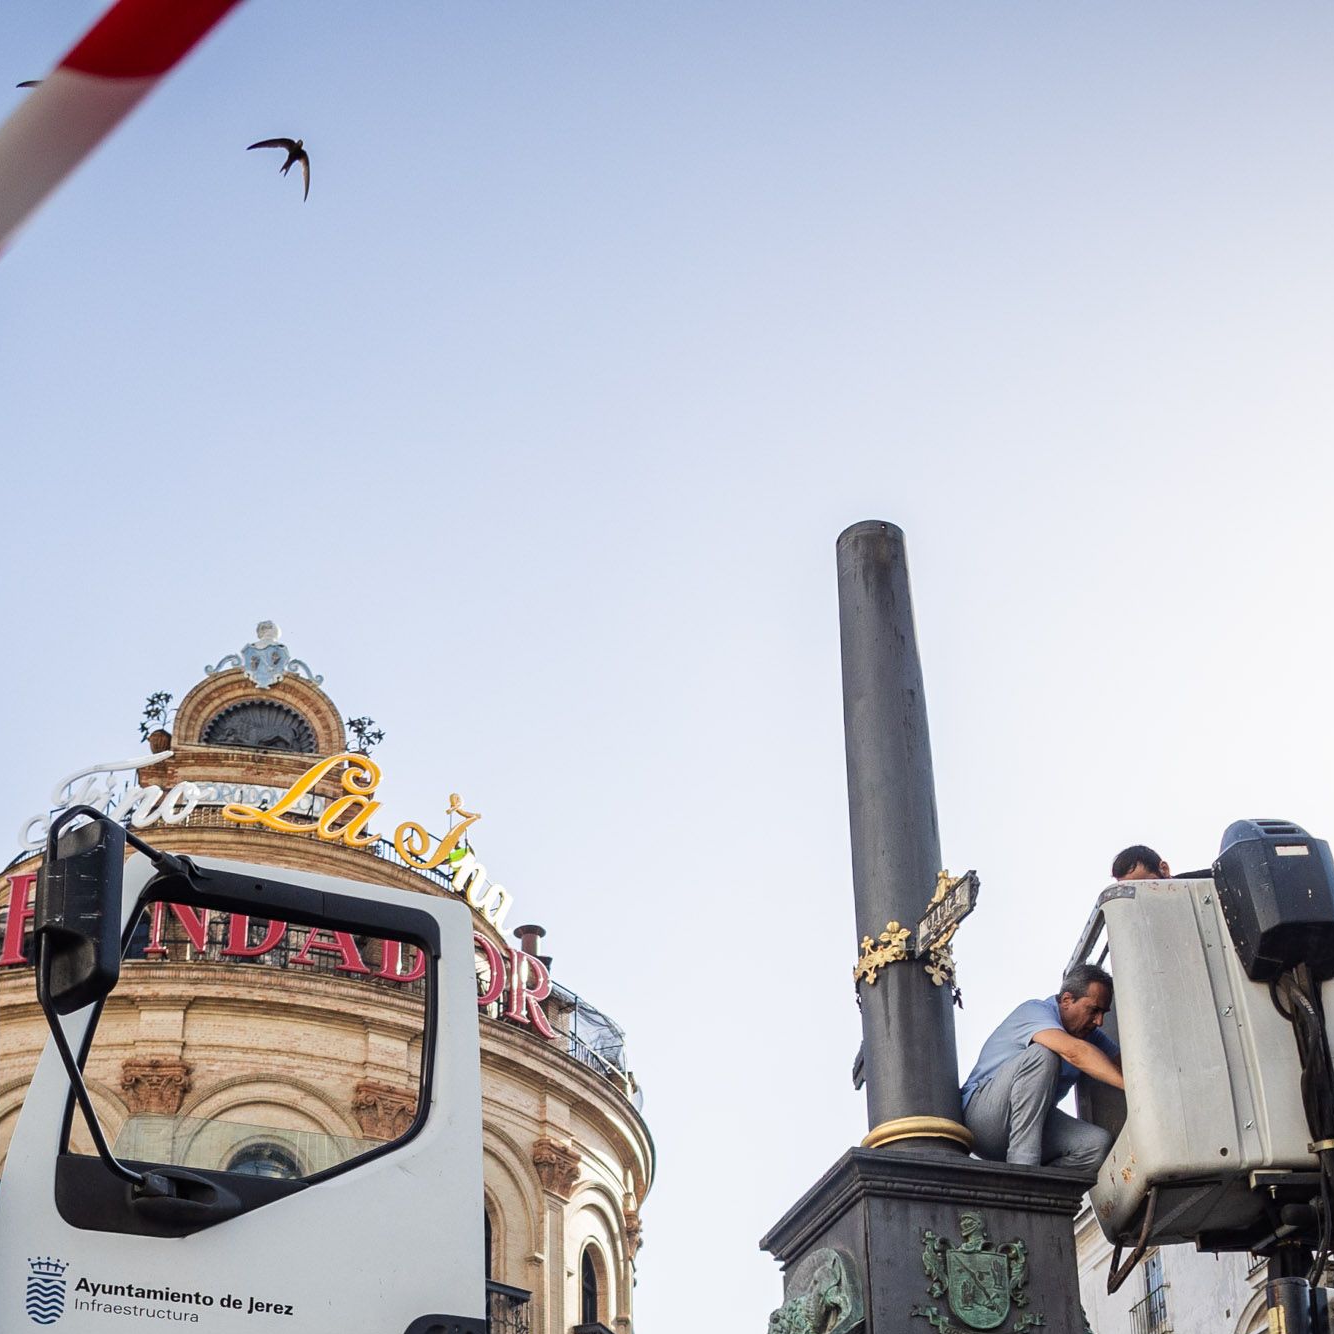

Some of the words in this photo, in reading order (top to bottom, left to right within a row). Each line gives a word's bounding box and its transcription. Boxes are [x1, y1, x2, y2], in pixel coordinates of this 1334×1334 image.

[222, 753, 384, 846] La
[75, 1277, 214, 1307] Ayuntamiento
[220, 1294, 243, 1310] de
[248, 1297, 294, 1316] Jerez
[75, 1298, 199, 1323] Infraestructura
